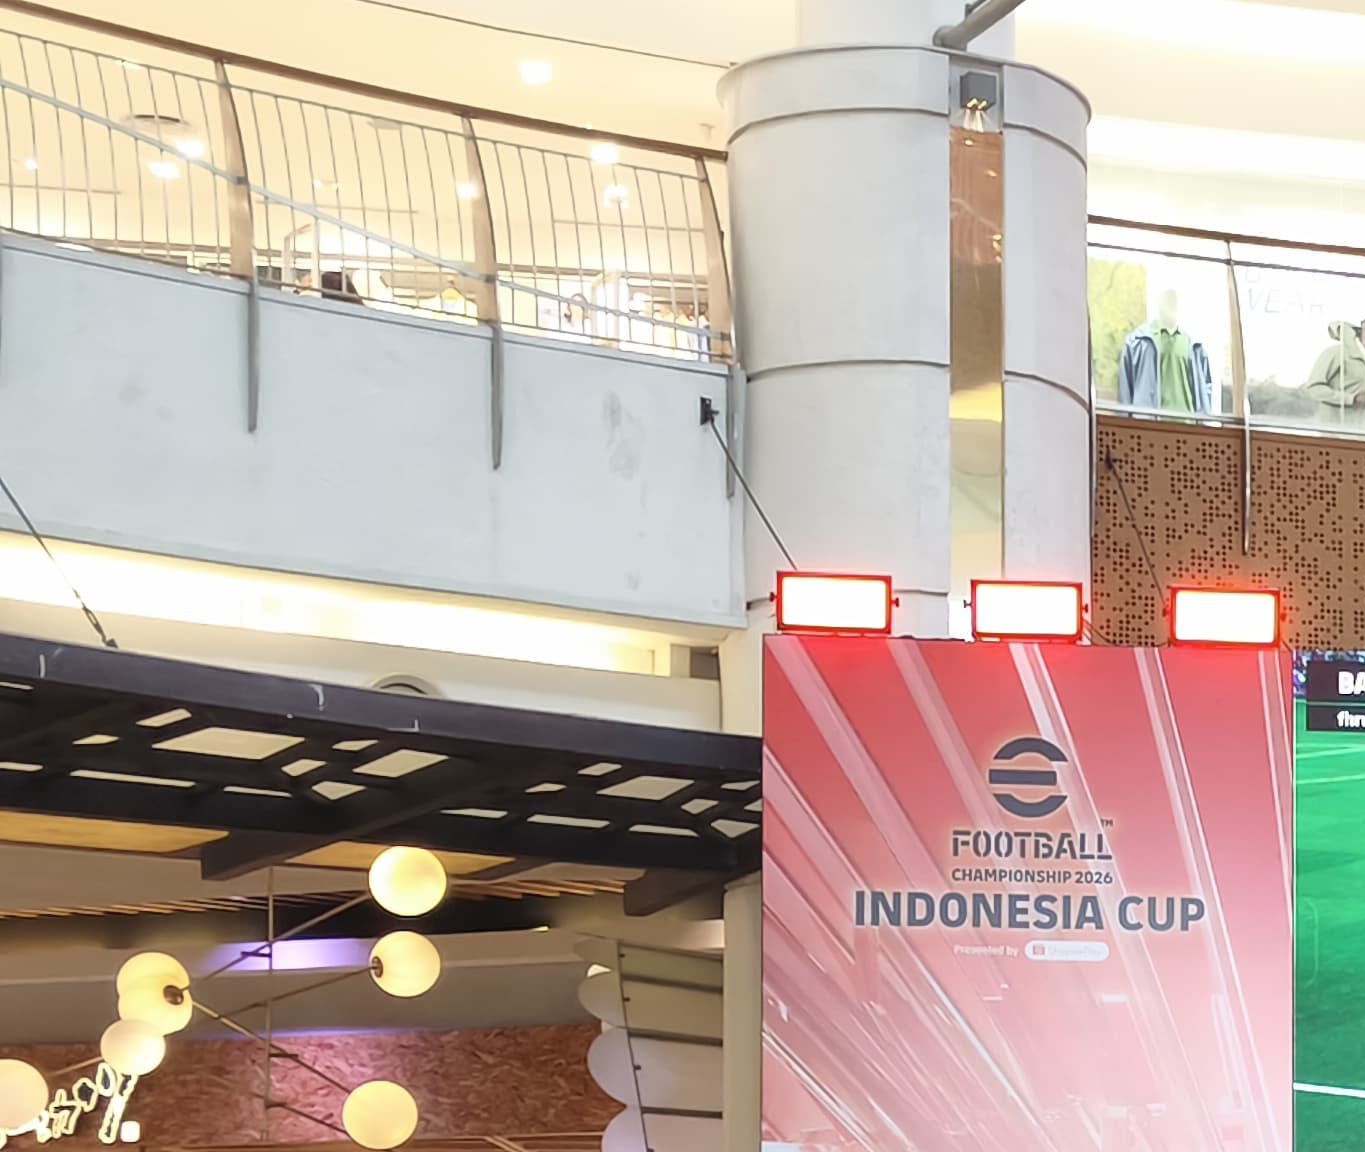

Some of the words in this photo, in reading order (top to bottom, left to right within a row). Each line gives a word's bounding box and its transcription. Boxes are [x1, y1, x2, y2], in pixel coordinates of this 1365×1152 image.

[952, 829, 1112, 861] FOOTBALL
[951, 868, 1072, 884] CHAMPIONSHIP
[1075, 870, 1113, 885] 2026
[855, 889, 1104, 930] INDONESIA
[1118, 896, 1206, 932] CUP
